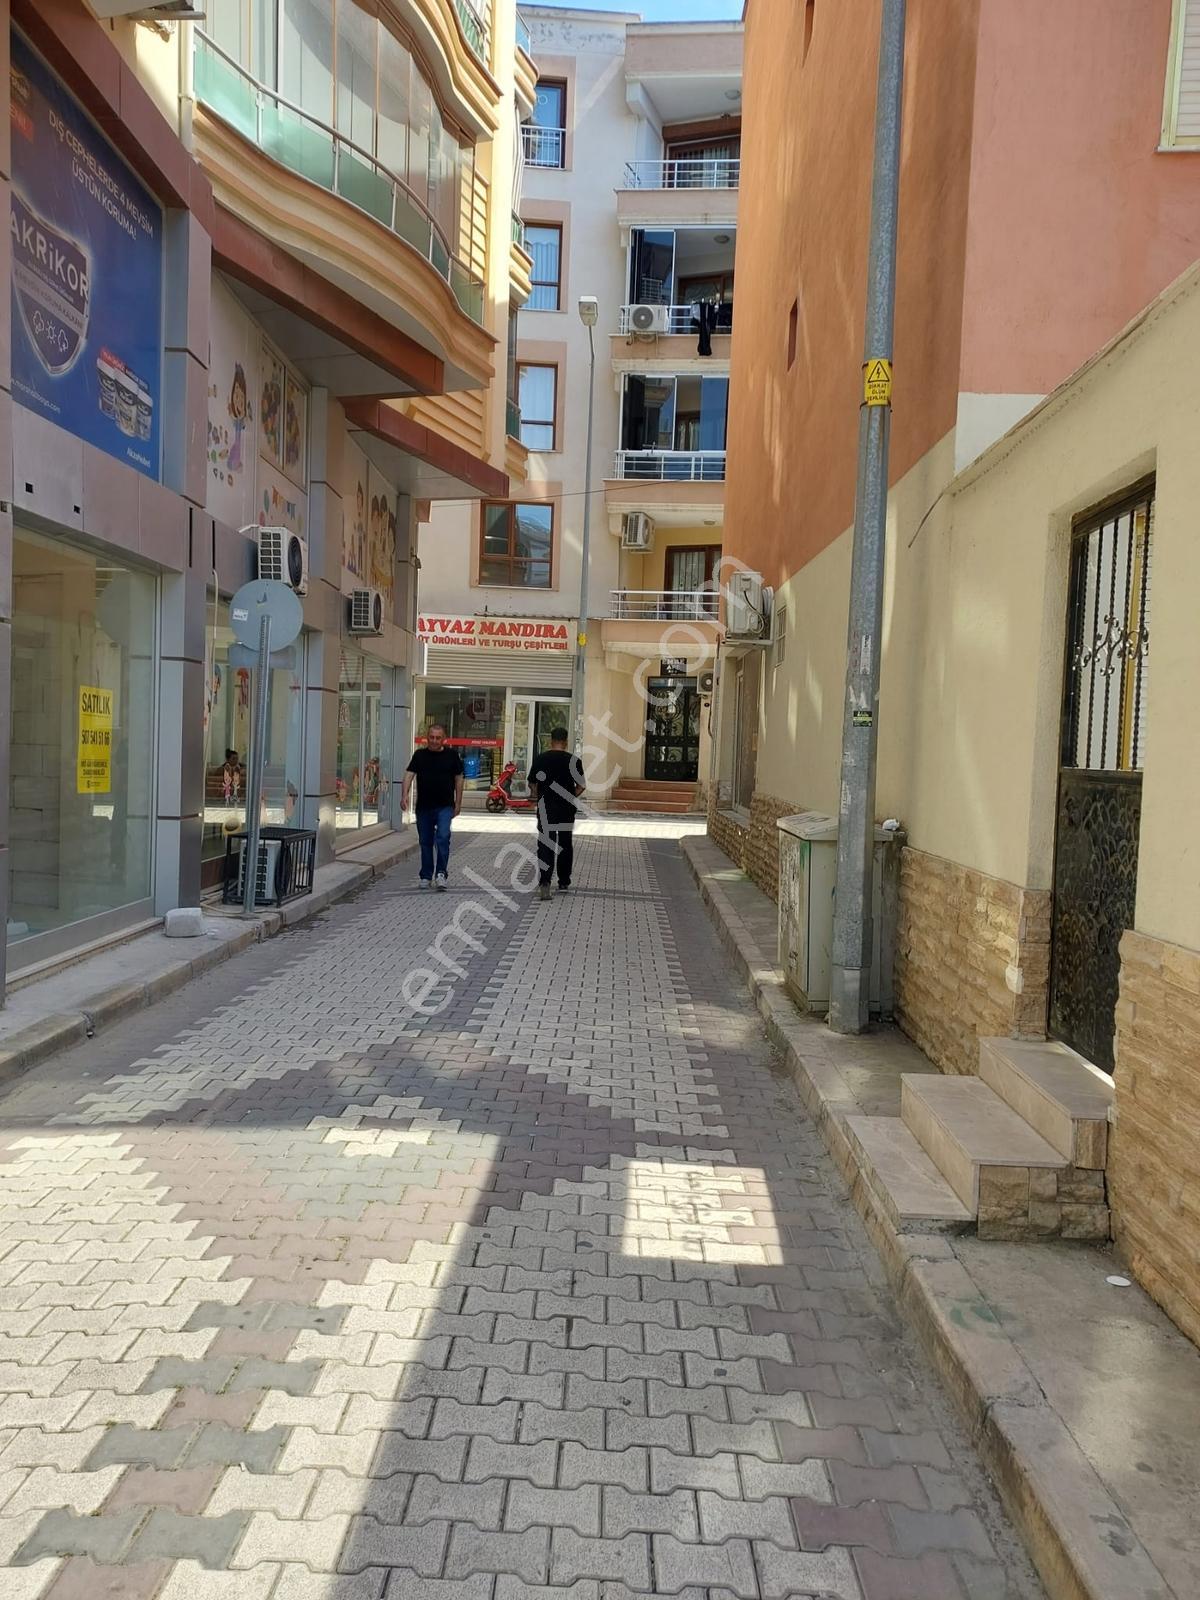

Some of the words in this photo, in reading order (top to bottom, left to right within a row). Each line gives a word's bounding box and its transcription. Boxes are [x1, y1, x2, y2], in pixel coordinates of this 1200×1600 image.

[49, 109, 65, 142] DIŞ
[65, 129, 119, 200] CEPHELERDE
[119, 192, 126, 206] 4
[126, 197, 154, 238] MEVSİM
[72, 156, 101, 202] ÜSTÜN
[101, 192, 137, 240] KORUMA!
[417, 617, 475, 634] AYVAZ
[478, 620, 568, 639] MANDIRA
[432, 635, 476, 646] ÜRÜNLERİ
[478, 639, 491, 647] VE
[492, 640, 522, 649] TURŞU
[524, 640, 568, 650] ÇEŞİTLERİ
[82, 692, 111, 715] SATILIK
